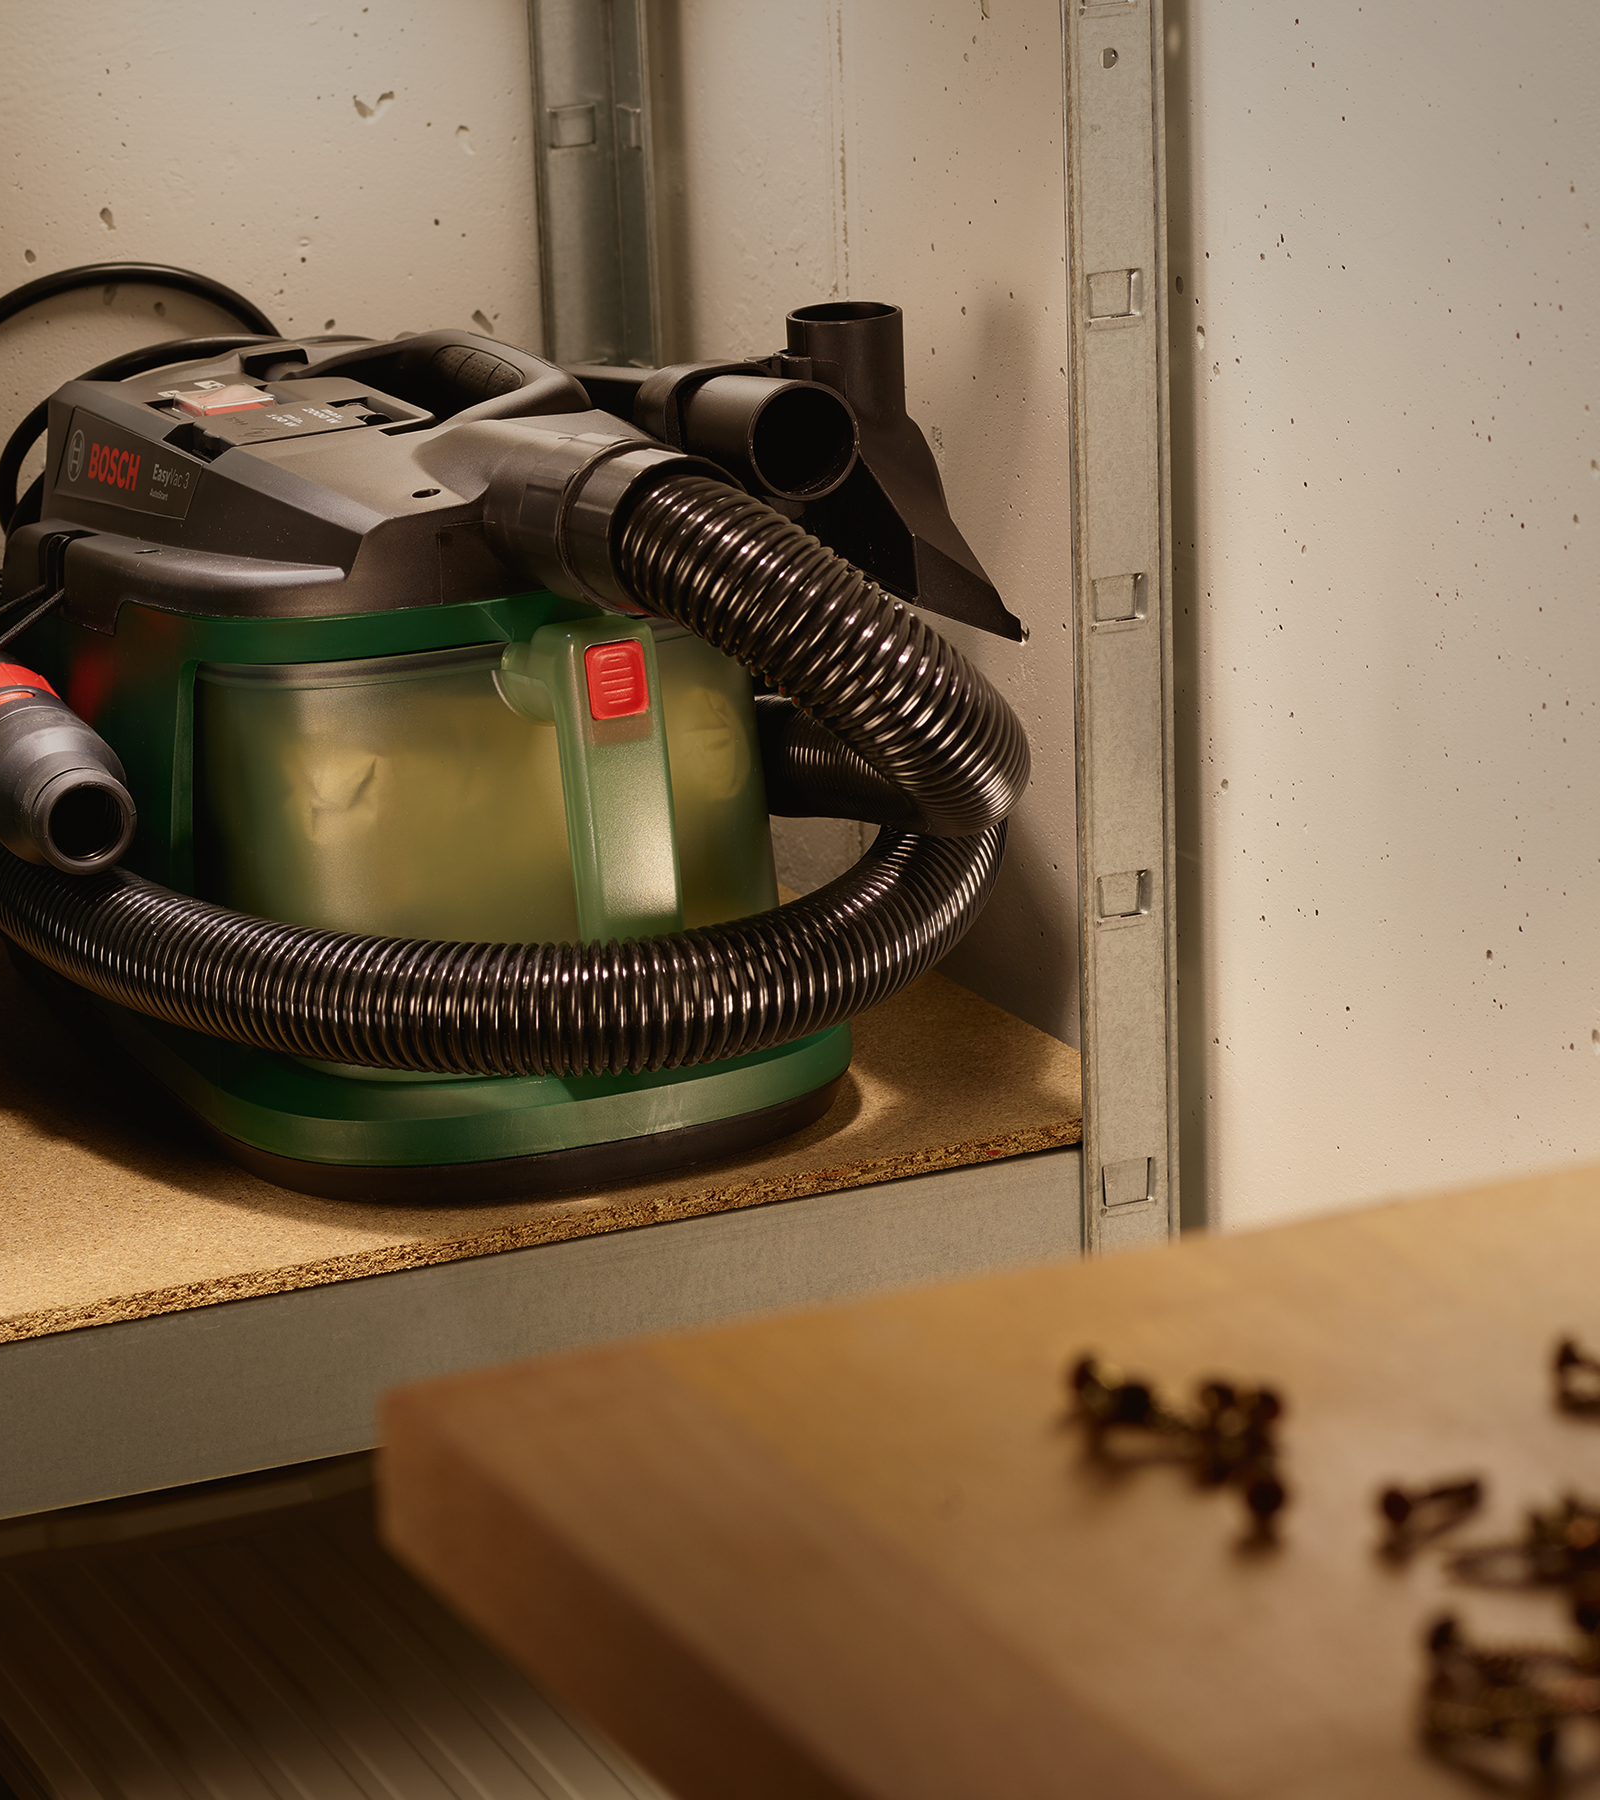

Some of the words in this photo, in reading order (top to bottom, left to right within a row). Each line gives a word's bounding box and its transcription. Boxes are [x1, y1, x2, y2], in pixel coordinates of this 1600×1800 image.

[87, 442, 141, 492] BOSCH
[152, 463, 183, 488] EasyVac
[182, 472, 191, 489] 3
[149, 488, 169, 501] AutoStart
